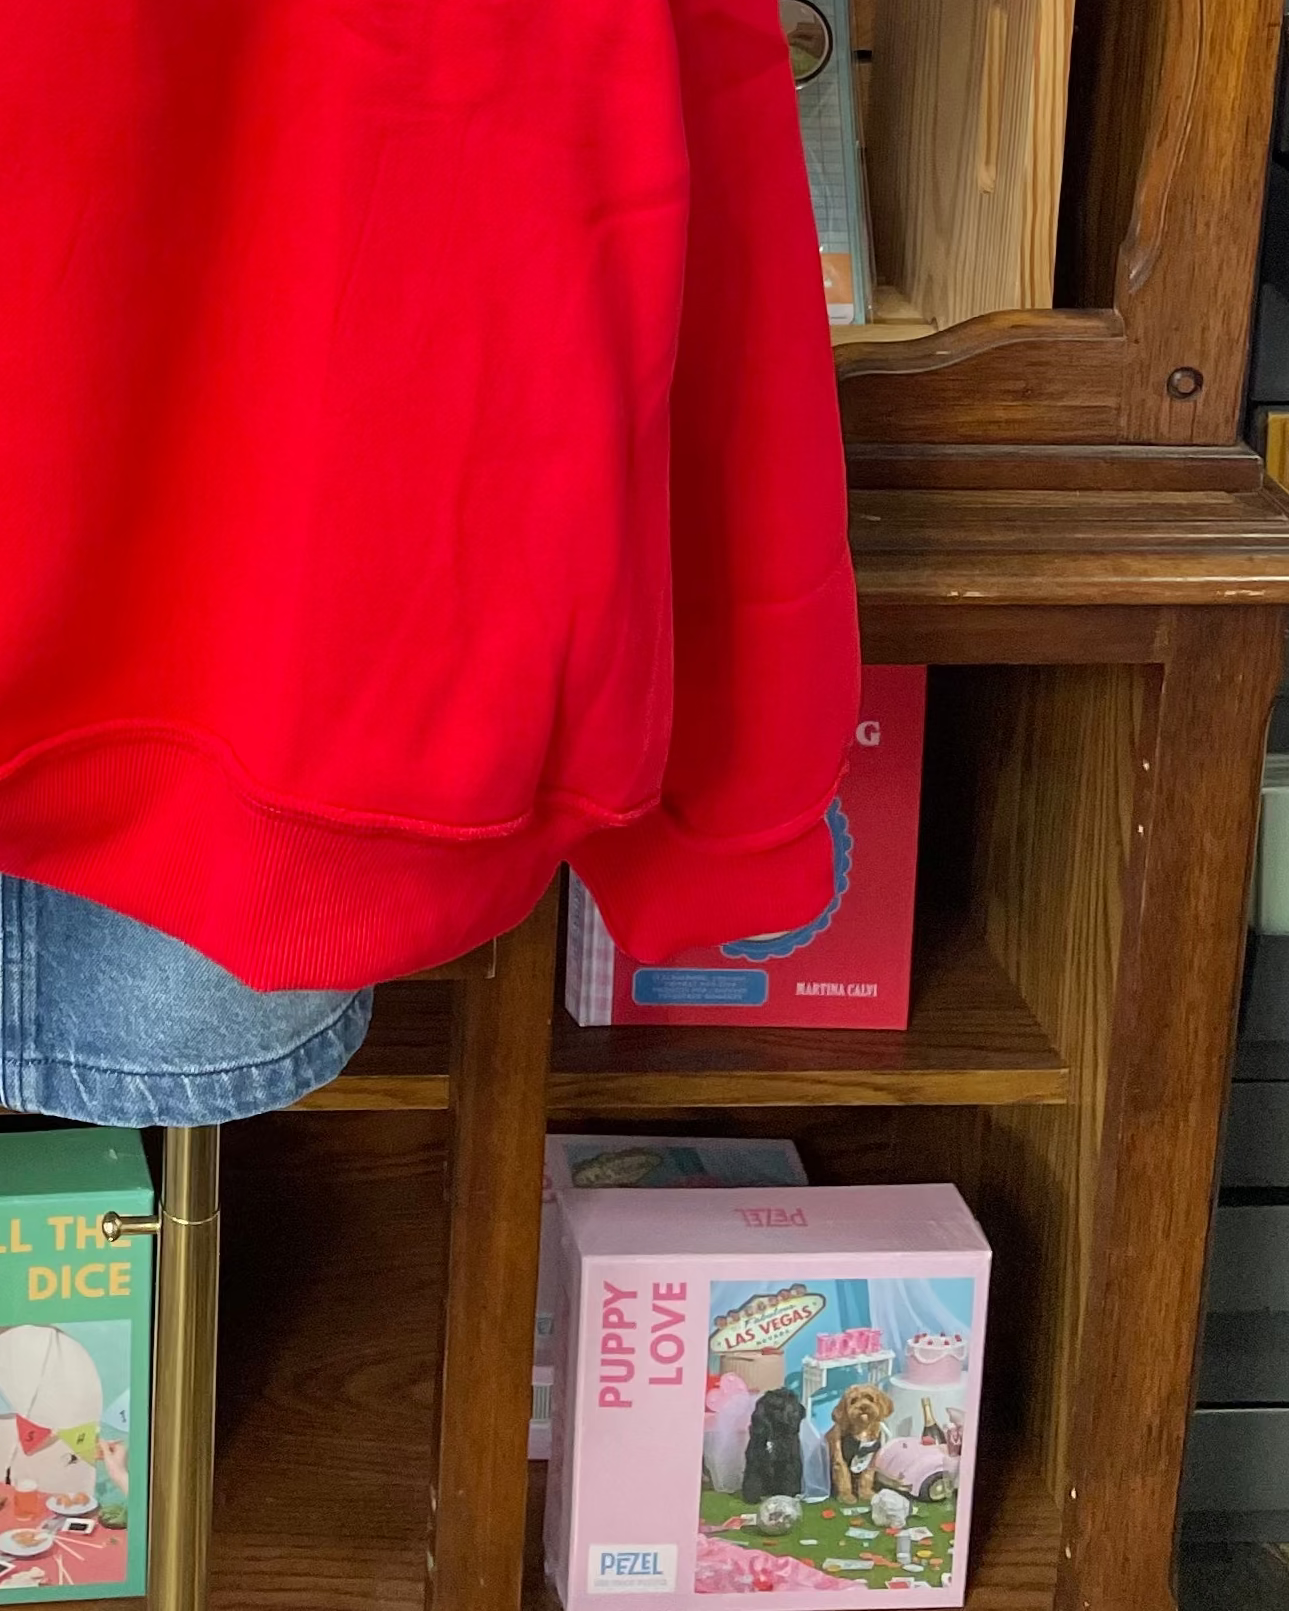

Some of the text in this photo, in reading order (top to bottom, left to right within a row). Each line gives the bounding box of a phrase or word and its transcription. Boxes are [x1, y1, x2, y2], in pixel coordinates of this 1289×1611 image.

[795, 982, 878, 997] MARTINA CALVI
[733, 1207, 809, 1228] PEZEL
[27, 1262, 132, 1301] DICE
[598, 1280, 638, 1408] PUPPY
[648, 1282, 687, 1385] LOVE
[724, 1328, 756, 1350] LAS
[759, 1305, 813, 1335] VEGAS
[600, 1552, 664, 1576] PEZEL
